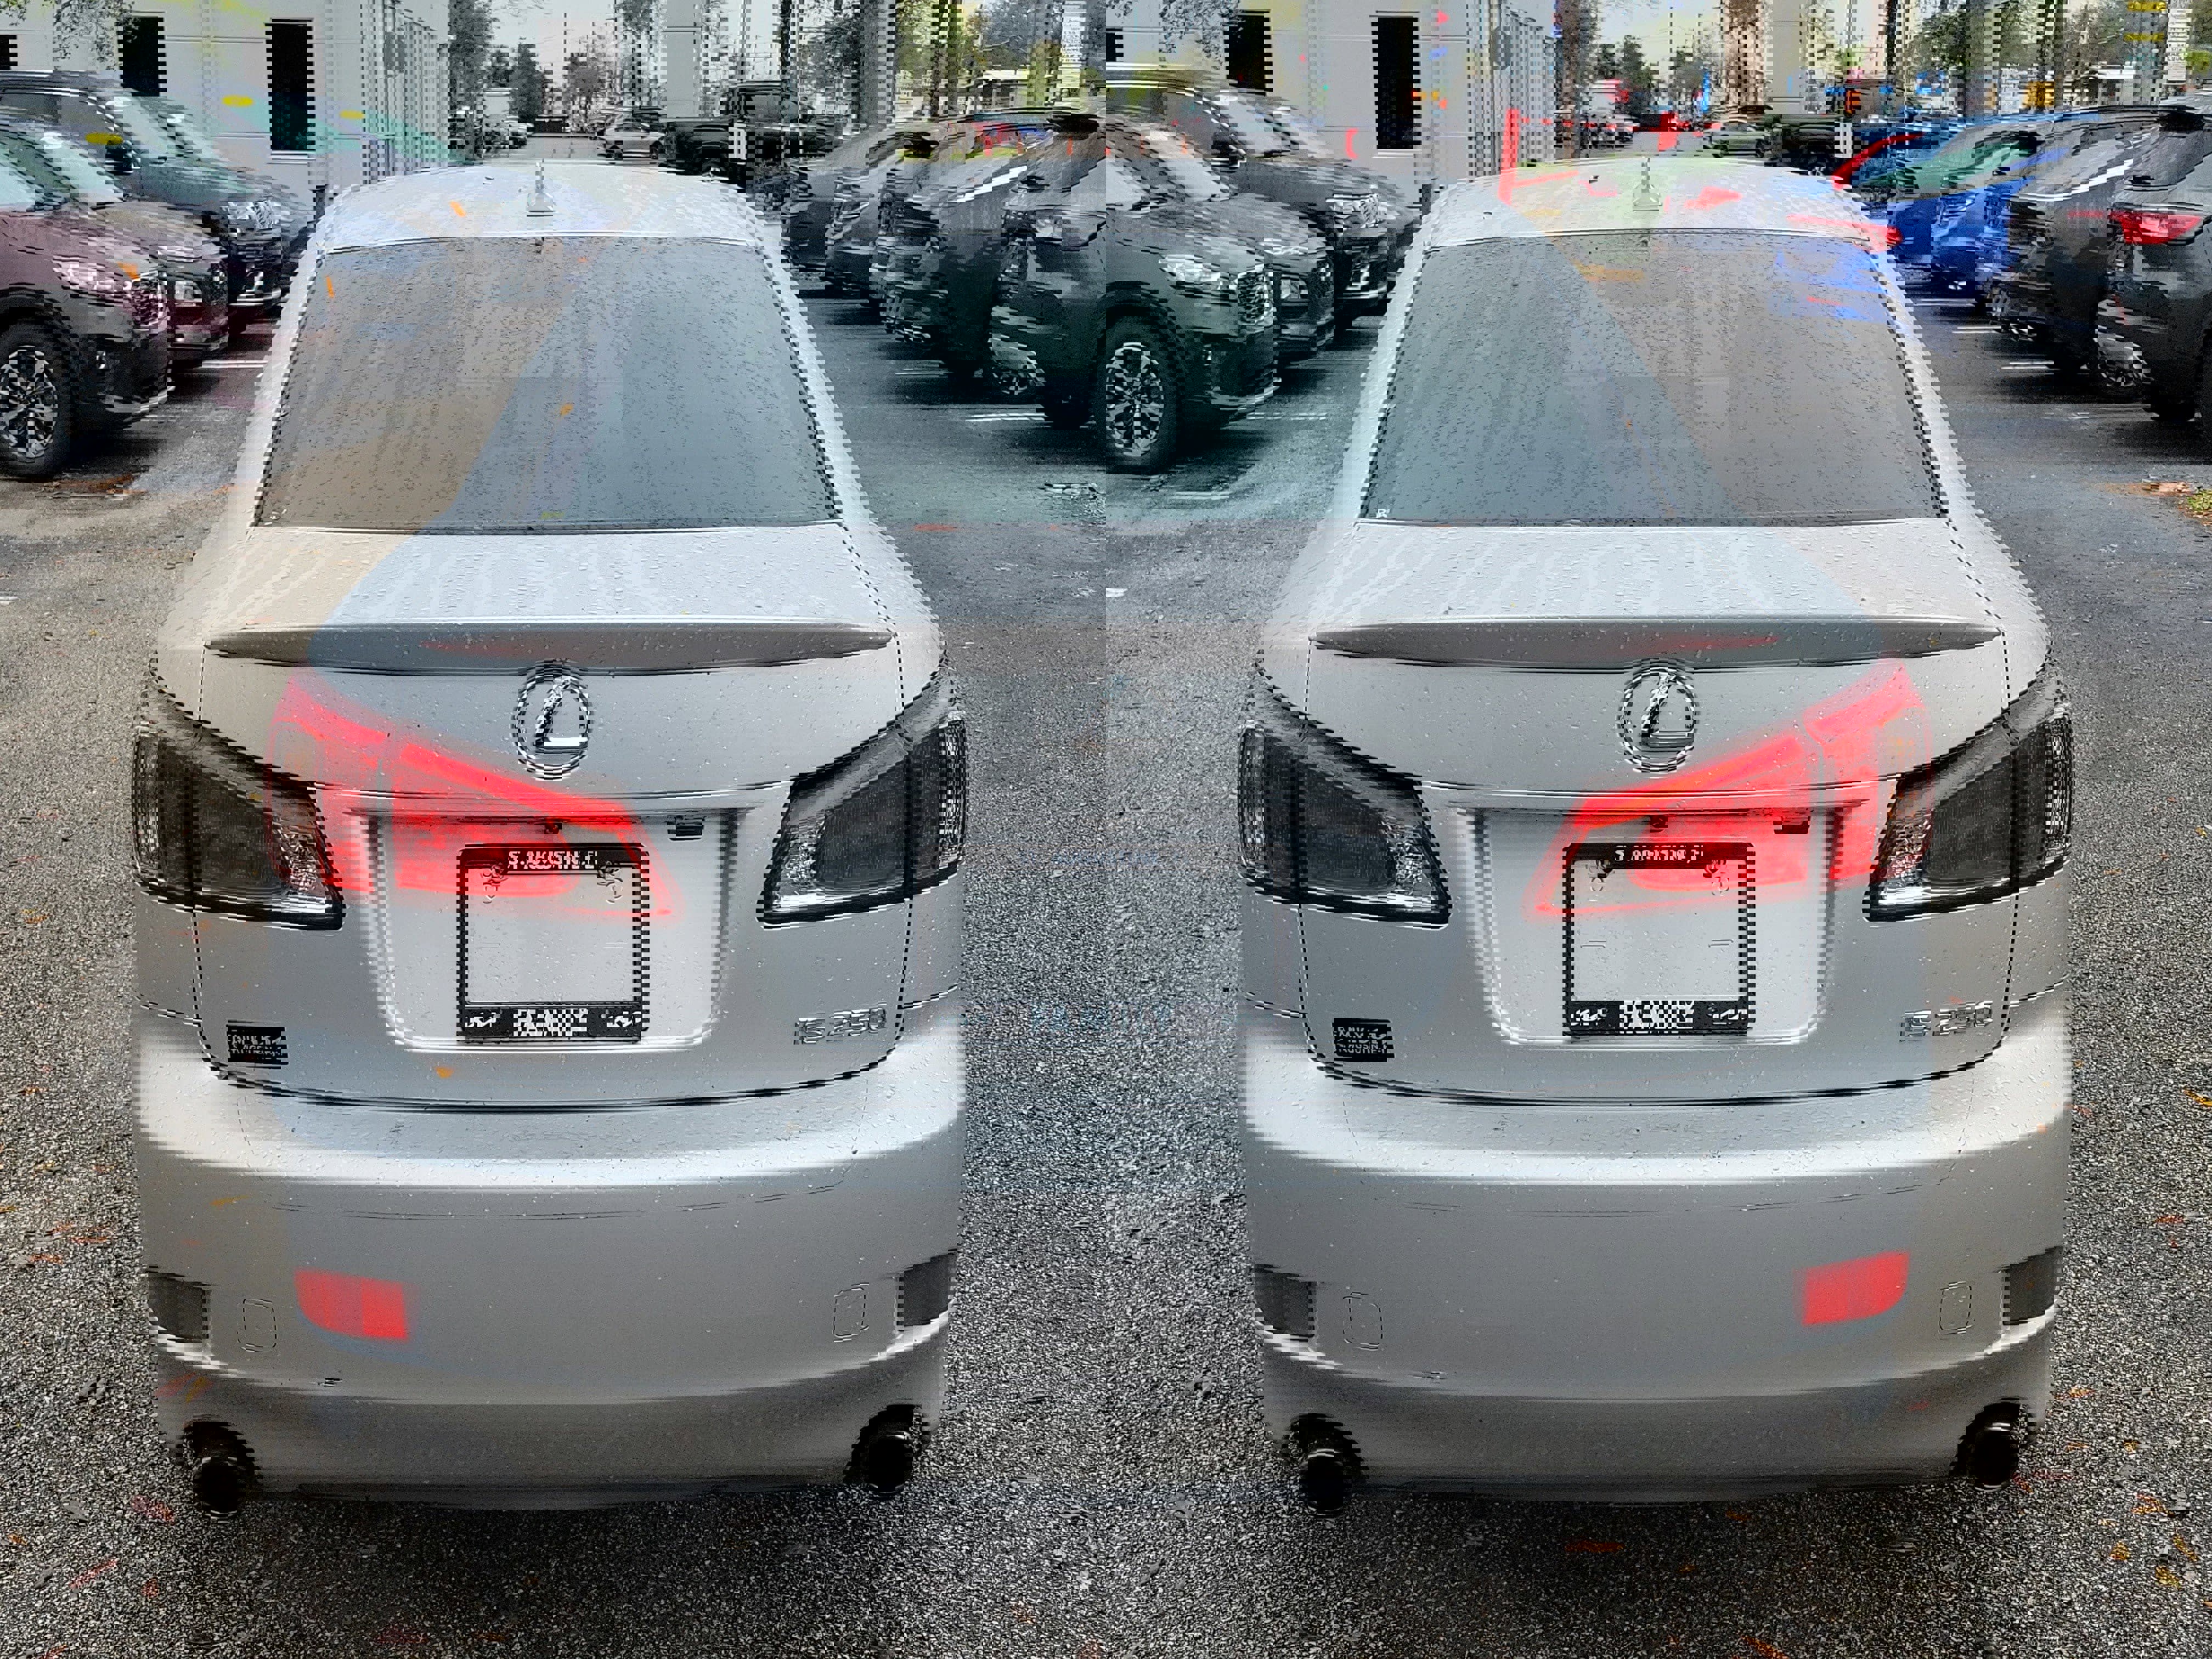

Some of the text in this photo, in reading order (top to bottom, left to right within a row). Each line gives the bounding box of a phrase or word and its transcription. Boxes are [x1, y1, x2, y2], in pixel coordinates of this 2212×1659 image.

[1016, 849, 1192, 868] ST. AUGUSTINE, FL
[1030, 1003, 1176, 1034] FAMILY
[1593, 1002, 1774, 1042] IS 250
[459, 1029, 513, 1043] FAMILY
[461, 1043, 564, 1057] ST. AUGUSTINE, FL
